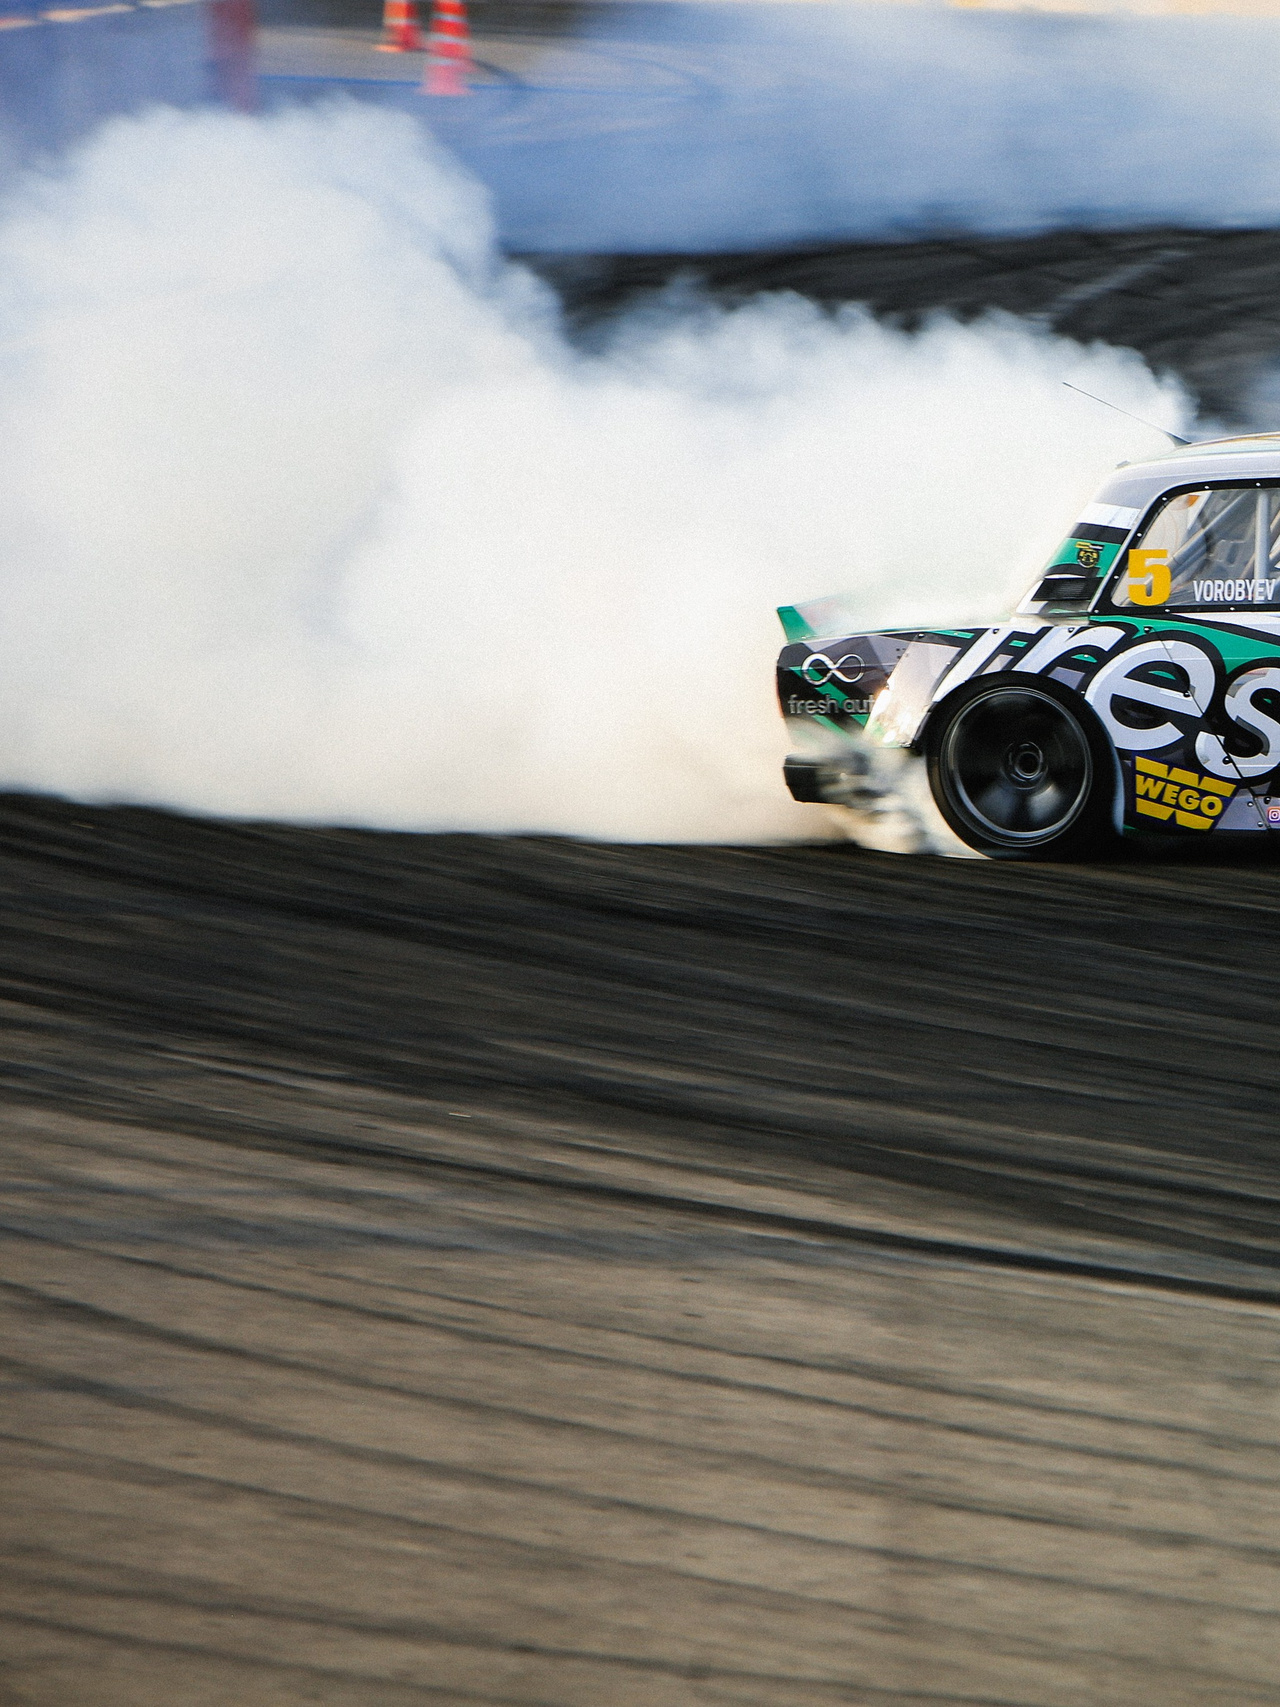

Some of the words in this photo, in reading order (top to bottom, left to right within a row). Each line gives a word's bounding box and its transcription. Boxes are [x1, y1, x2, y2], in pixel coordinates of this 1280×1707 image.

[1127, 548, 1172, 607] 5
[1193, 578, 1275, 602] VOROBYEV
[788, 694, 840, 714] fresh
[843, 694, 875, 714] aut
[1135, 773, 1224, 817] WEGO
